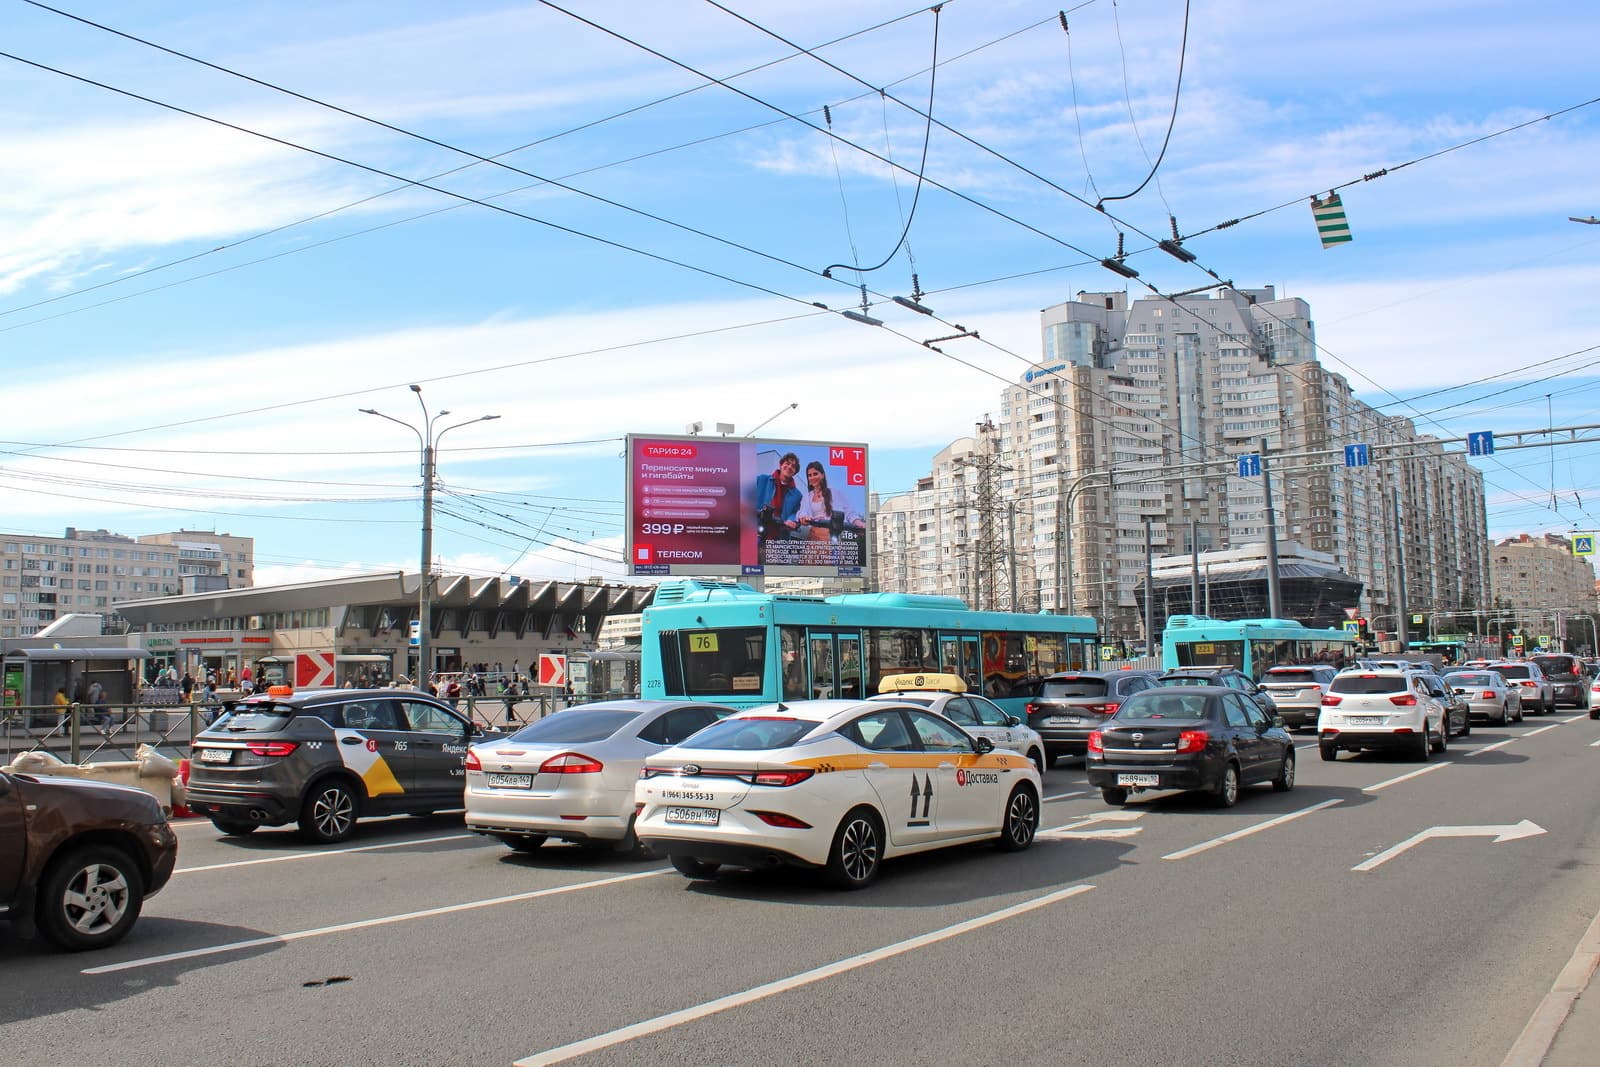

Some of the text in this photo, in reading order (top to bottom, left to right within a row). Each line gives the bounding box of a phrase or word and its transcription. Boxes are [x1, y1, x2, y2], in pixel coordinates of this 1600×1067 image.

[832, 450, 862, 460] М Т
[642, 464, 694, 472] Переносите
[649, 472, 694, 480] гигабайты
[853, 474, 863, 482] С
[642, 524, 672, 534] 399
[657, 550, 702, 558] ТЕЛЕКОМ
[697, 637, 710, 648] 76
[394, 741, 408, 750] 765
[966, 770, 998, 786] Доставка
[682, 792, 714, 800] 345-55-33
[668, 808, 717, 820] С506ВН 198
